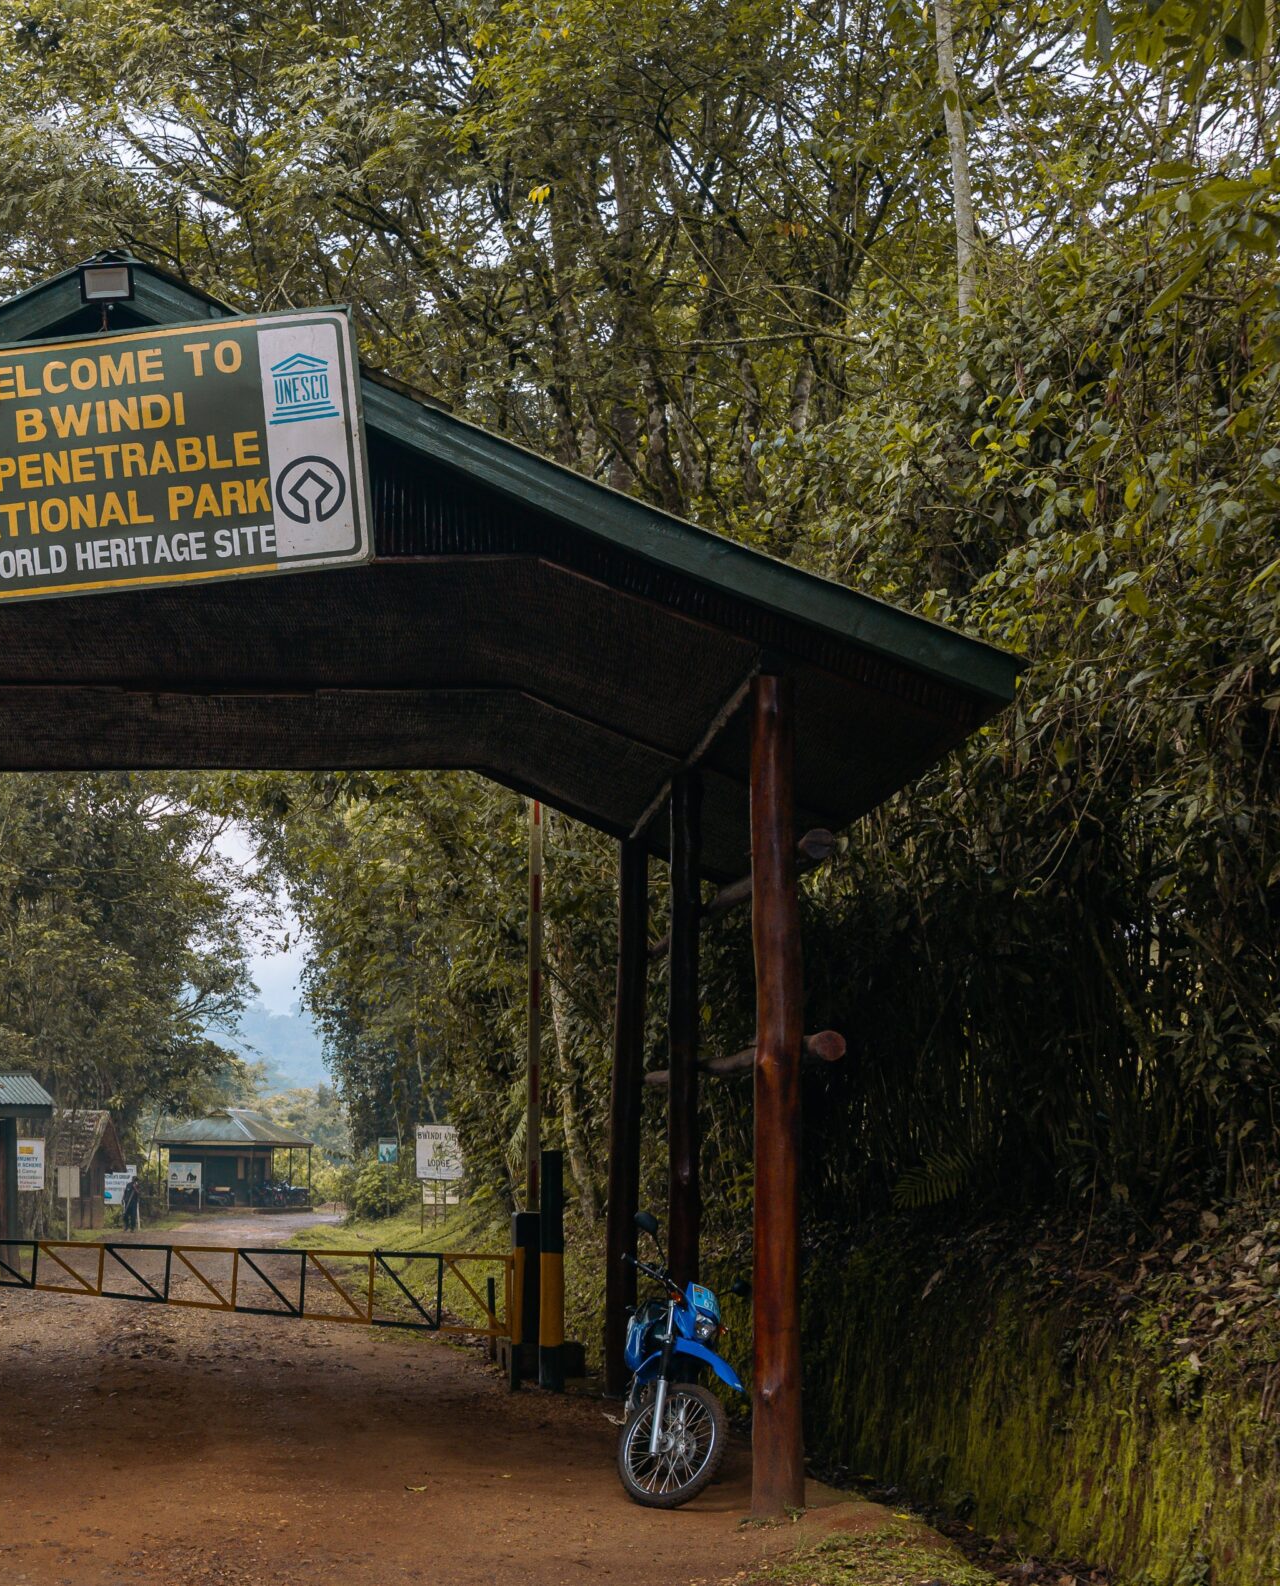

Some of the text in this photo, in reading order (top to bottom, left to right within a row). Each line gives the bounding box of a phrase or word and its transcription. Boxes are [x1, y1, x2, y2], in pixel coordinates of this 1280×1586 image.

[183, 339, 242, 377] TO
[274, 373, 329, 405] UNESCO
[15, 391, 186, 443] BWINDI
[167, 477, 272, 521] PARK
[74, 531, 208, 571] HERITAGE
[213, 524, 277, 558] SITE
[417, 1130, 442, 1140] BWINDI
[427, 1158, 451, 1168] LODGE
